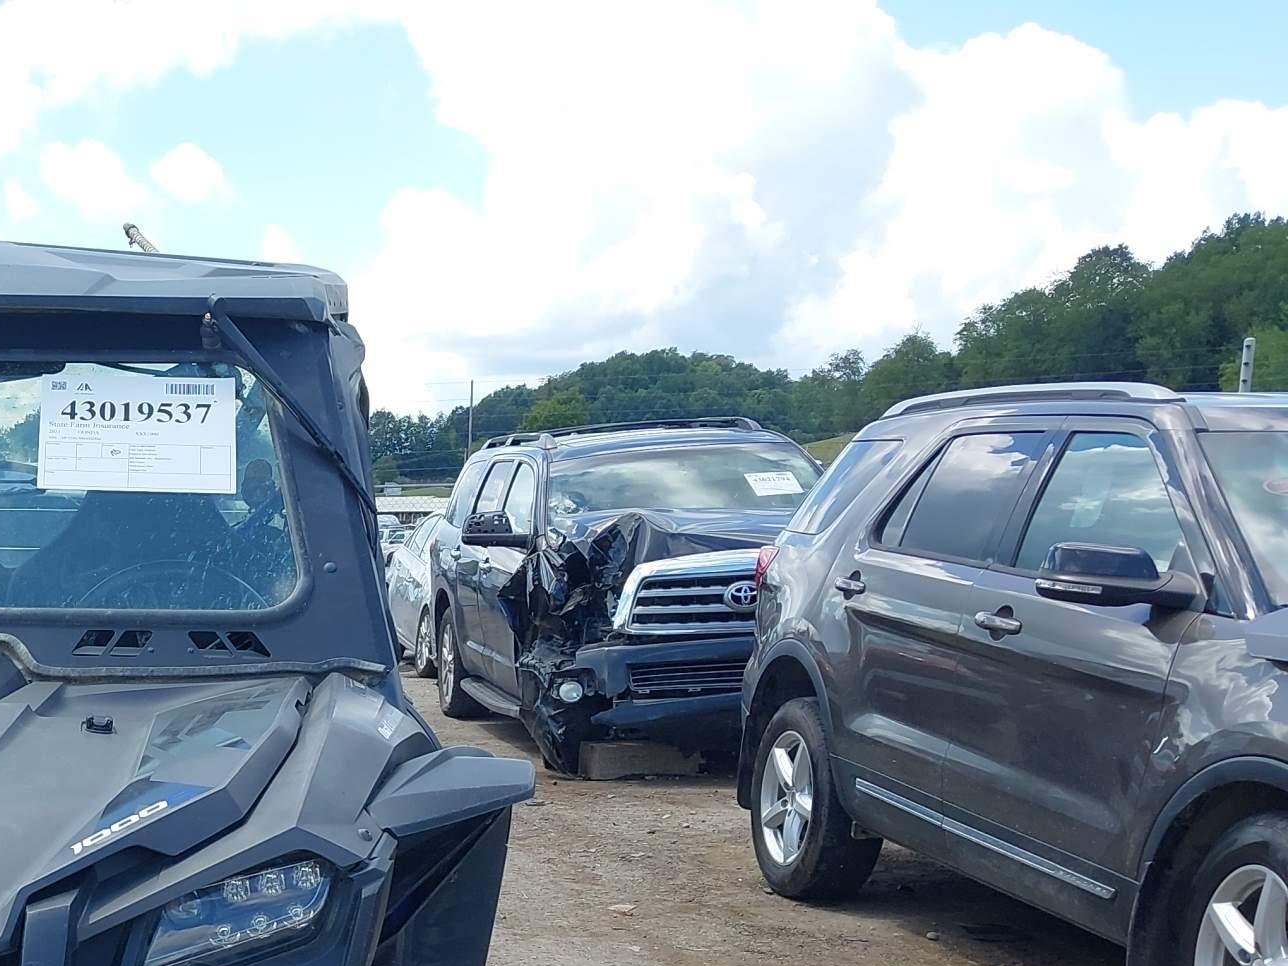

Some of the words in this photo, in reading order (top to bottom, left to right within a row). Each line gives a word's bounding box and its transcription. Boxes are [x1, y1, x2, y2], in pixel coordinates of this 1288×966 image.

[61, 400, 212, 424] 43019537
[70, 421, 91, 429] Farm
[92, 422, 130, 430] Insurance
[70, 799, 168, 855] 1000
